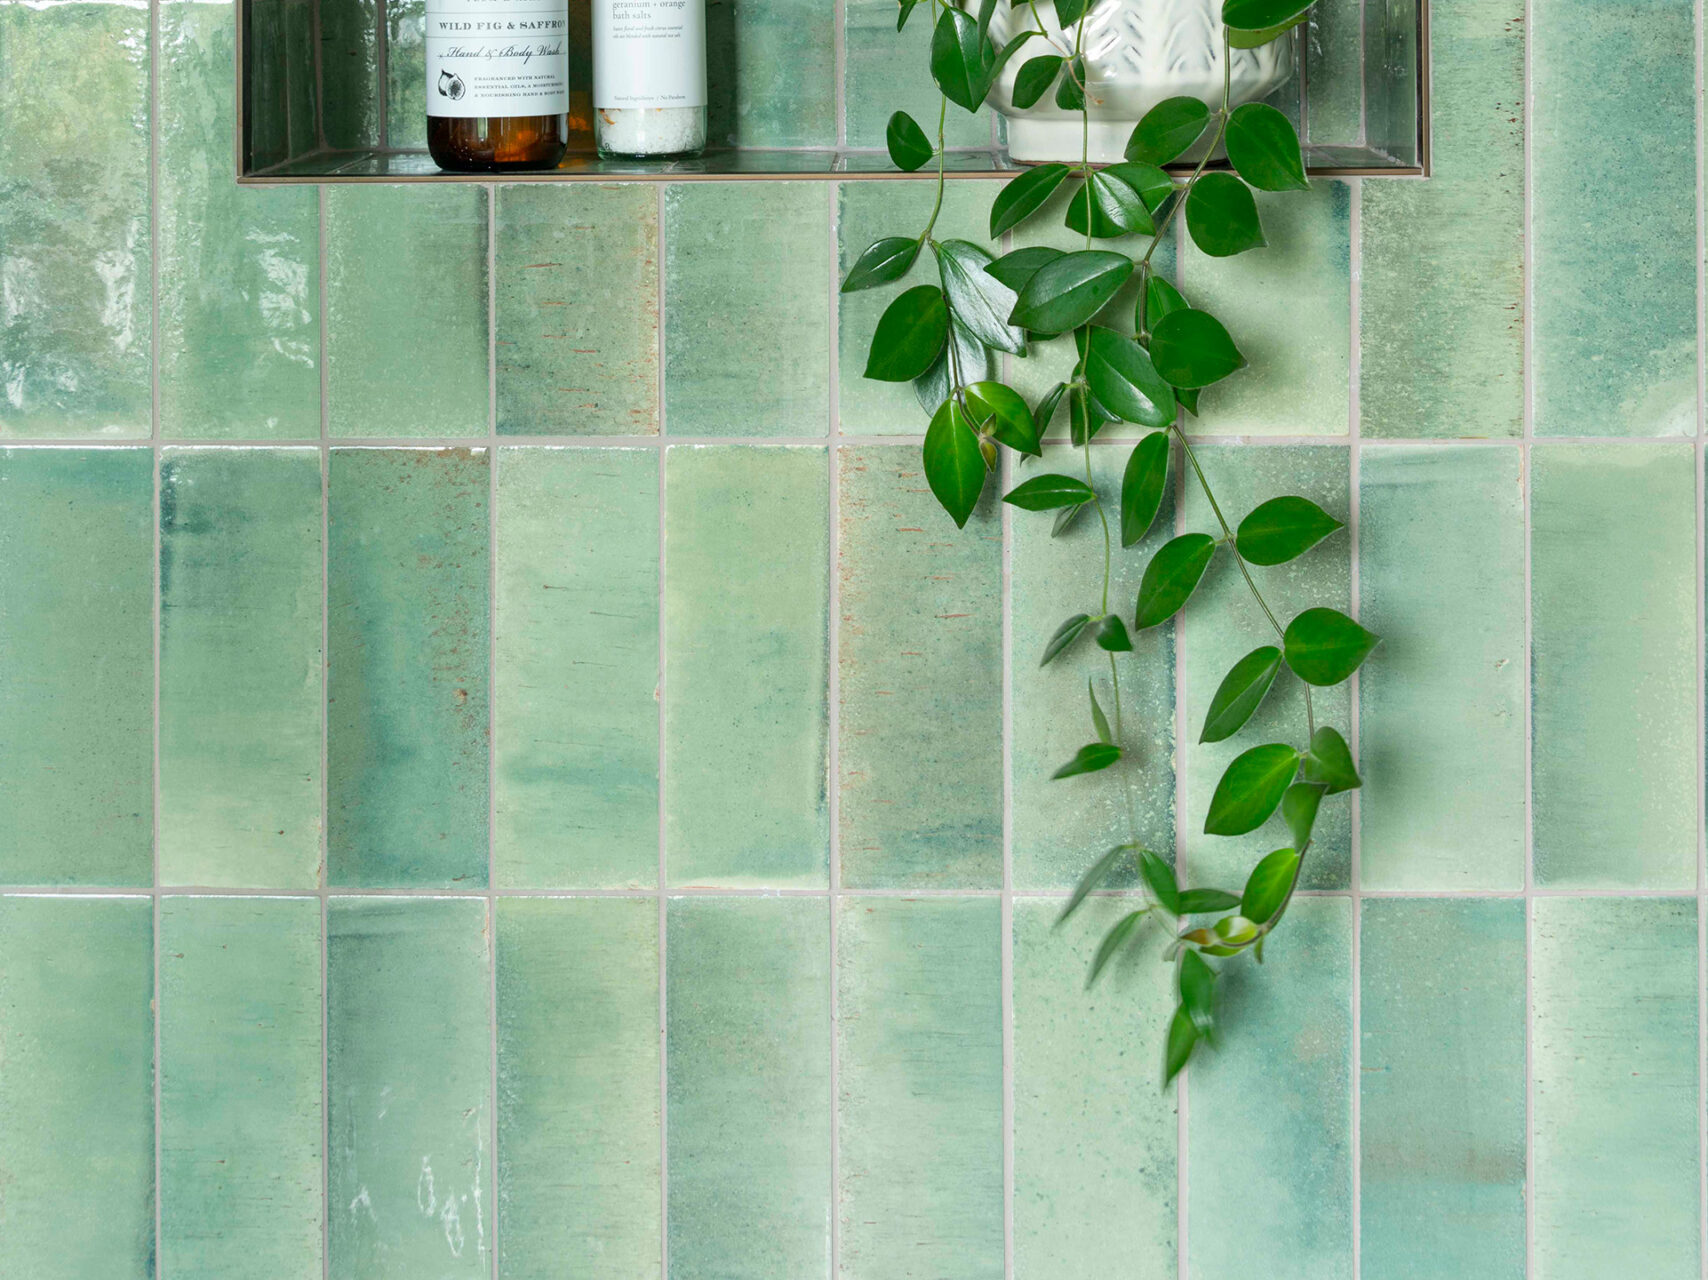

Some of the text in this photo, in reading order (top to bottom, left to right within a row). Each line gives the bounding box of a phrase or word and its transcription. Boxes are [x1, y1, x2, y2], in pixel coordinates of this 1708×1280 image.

[612, 0, 650, 10] geranium
[660, 0, 686, 10] orange
[612, 10, 652, 20] bath salts
[440, 22, 472, 30] WILD
[477, 22, 502, 30] FIG
[506, 22, 515, 30] &
[446, 42, 562, 65] Hand & Body Wash
